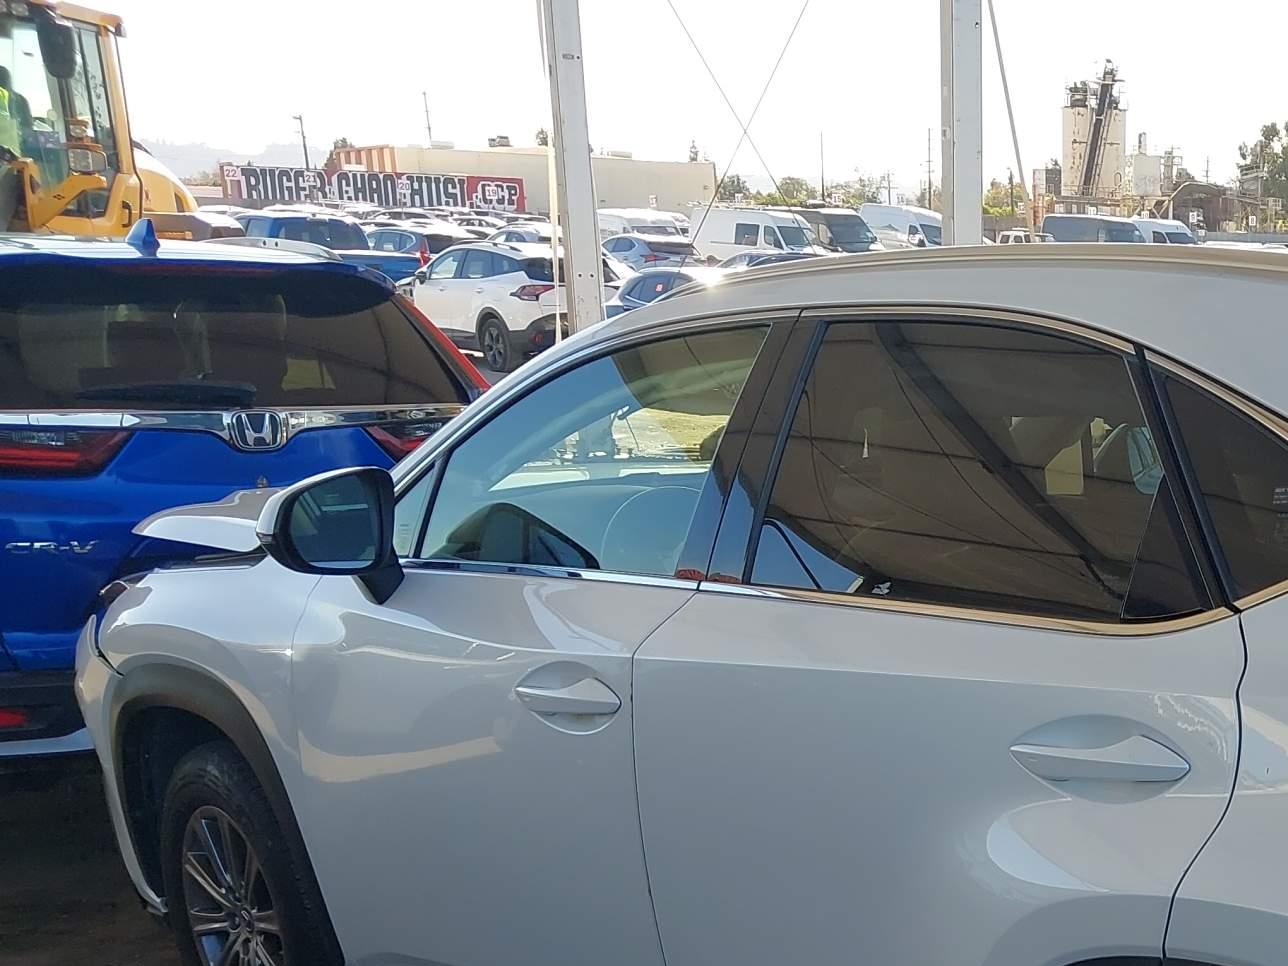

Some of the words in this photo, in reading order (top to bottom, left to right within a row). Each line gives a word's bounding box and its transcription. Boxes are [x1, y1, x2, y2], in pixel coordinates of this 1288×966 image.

[225, 168, 238, 178] 22
[305, 173, 317, 183] 21
[399, 180, 411, 191] 20
[487, 188, 498, 198] 19
[5, 539, 100, 555] CR-V
